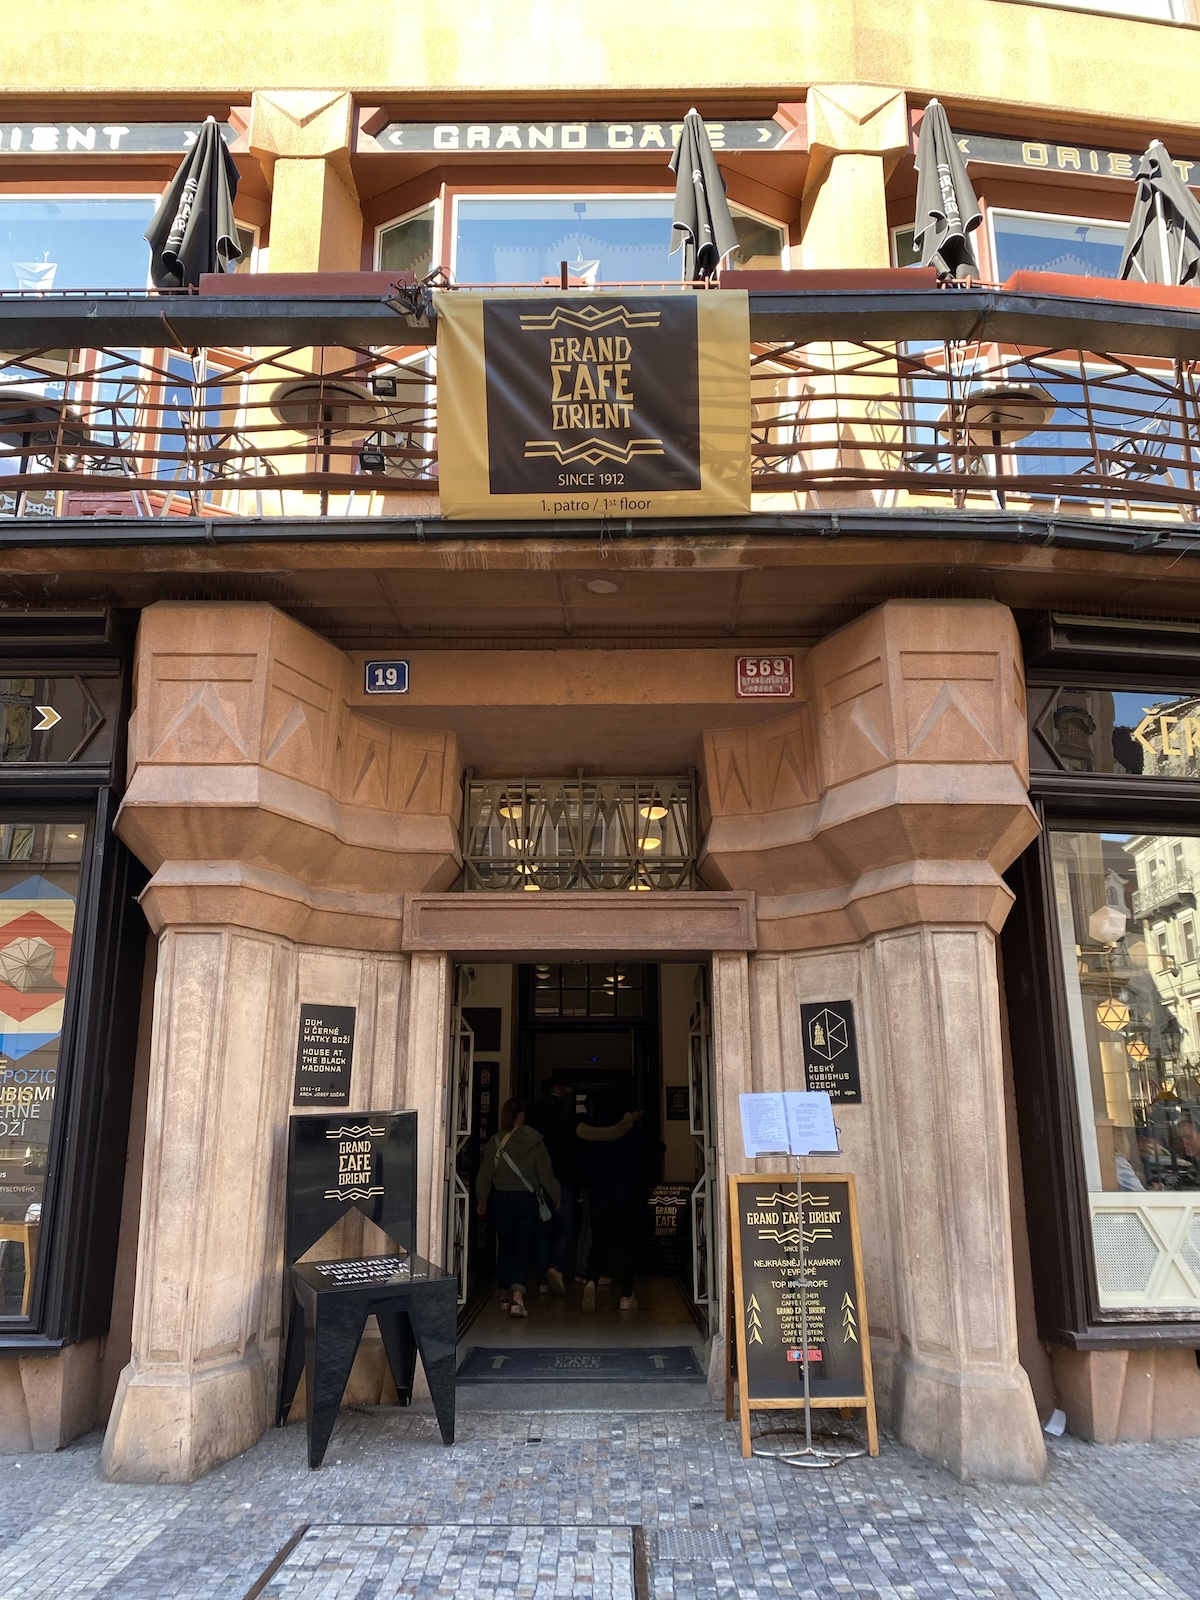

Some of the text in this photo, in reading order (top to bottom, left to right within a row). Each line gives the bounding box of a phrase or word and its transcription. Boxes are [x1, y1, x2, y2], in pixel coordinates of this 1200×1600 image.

[0, 126, 130, 151] IENT
[433, 125, 587, 149] GRAND
[1022, 142, 1195, 182] ORIET
[550, 336, 632, 362] GRAND
[550, 363, 634, 402] CAFE
[551, 403, 634, 430] ORIENT
[558, 472, 625, 486] SINCE 1912
[541, 497, 652, 514] 1. patro / 1st floor
[746, 659, 785, 676] 569
[374, 667, 398, 686] 19
[304, 1018, 323, 1026] DOM
[312, 1026, 339, 1036] ČERNÉ
[304, 1035, 350, 1044] MATKY BOŽÍ
[302, 1048, 330, 1056] HOUSE
[302, 1056, 346, 1065] THE BLACK
[301, 1065, 341, 1073] MADONNA
[808, 1063, 835, 1073] ČESKÝ
[0, 1068, 56, 1084] POZIC
[809, 1072, 850, 1081] KUBISMUS
[809, 1081, 837, 1089] CZECH
[339, 1140, 371, 1154] GRAND
[339, 1153, 371, 1172] CAFE
[338, 1172, 371, 1185] ORIENT
[655, 1206, 678, 1215] GRAND
[655, 1215, 678, 1227] CAFE
[747, 1212, 779, 1225] GRAND
[809, 1211, 841, 1223] ORIENT
[754, 1257, 841, 1268] NEJKRÁSNĚJÍ KAVÁRNY
[797, 1280, 828, 1288] ROPE
